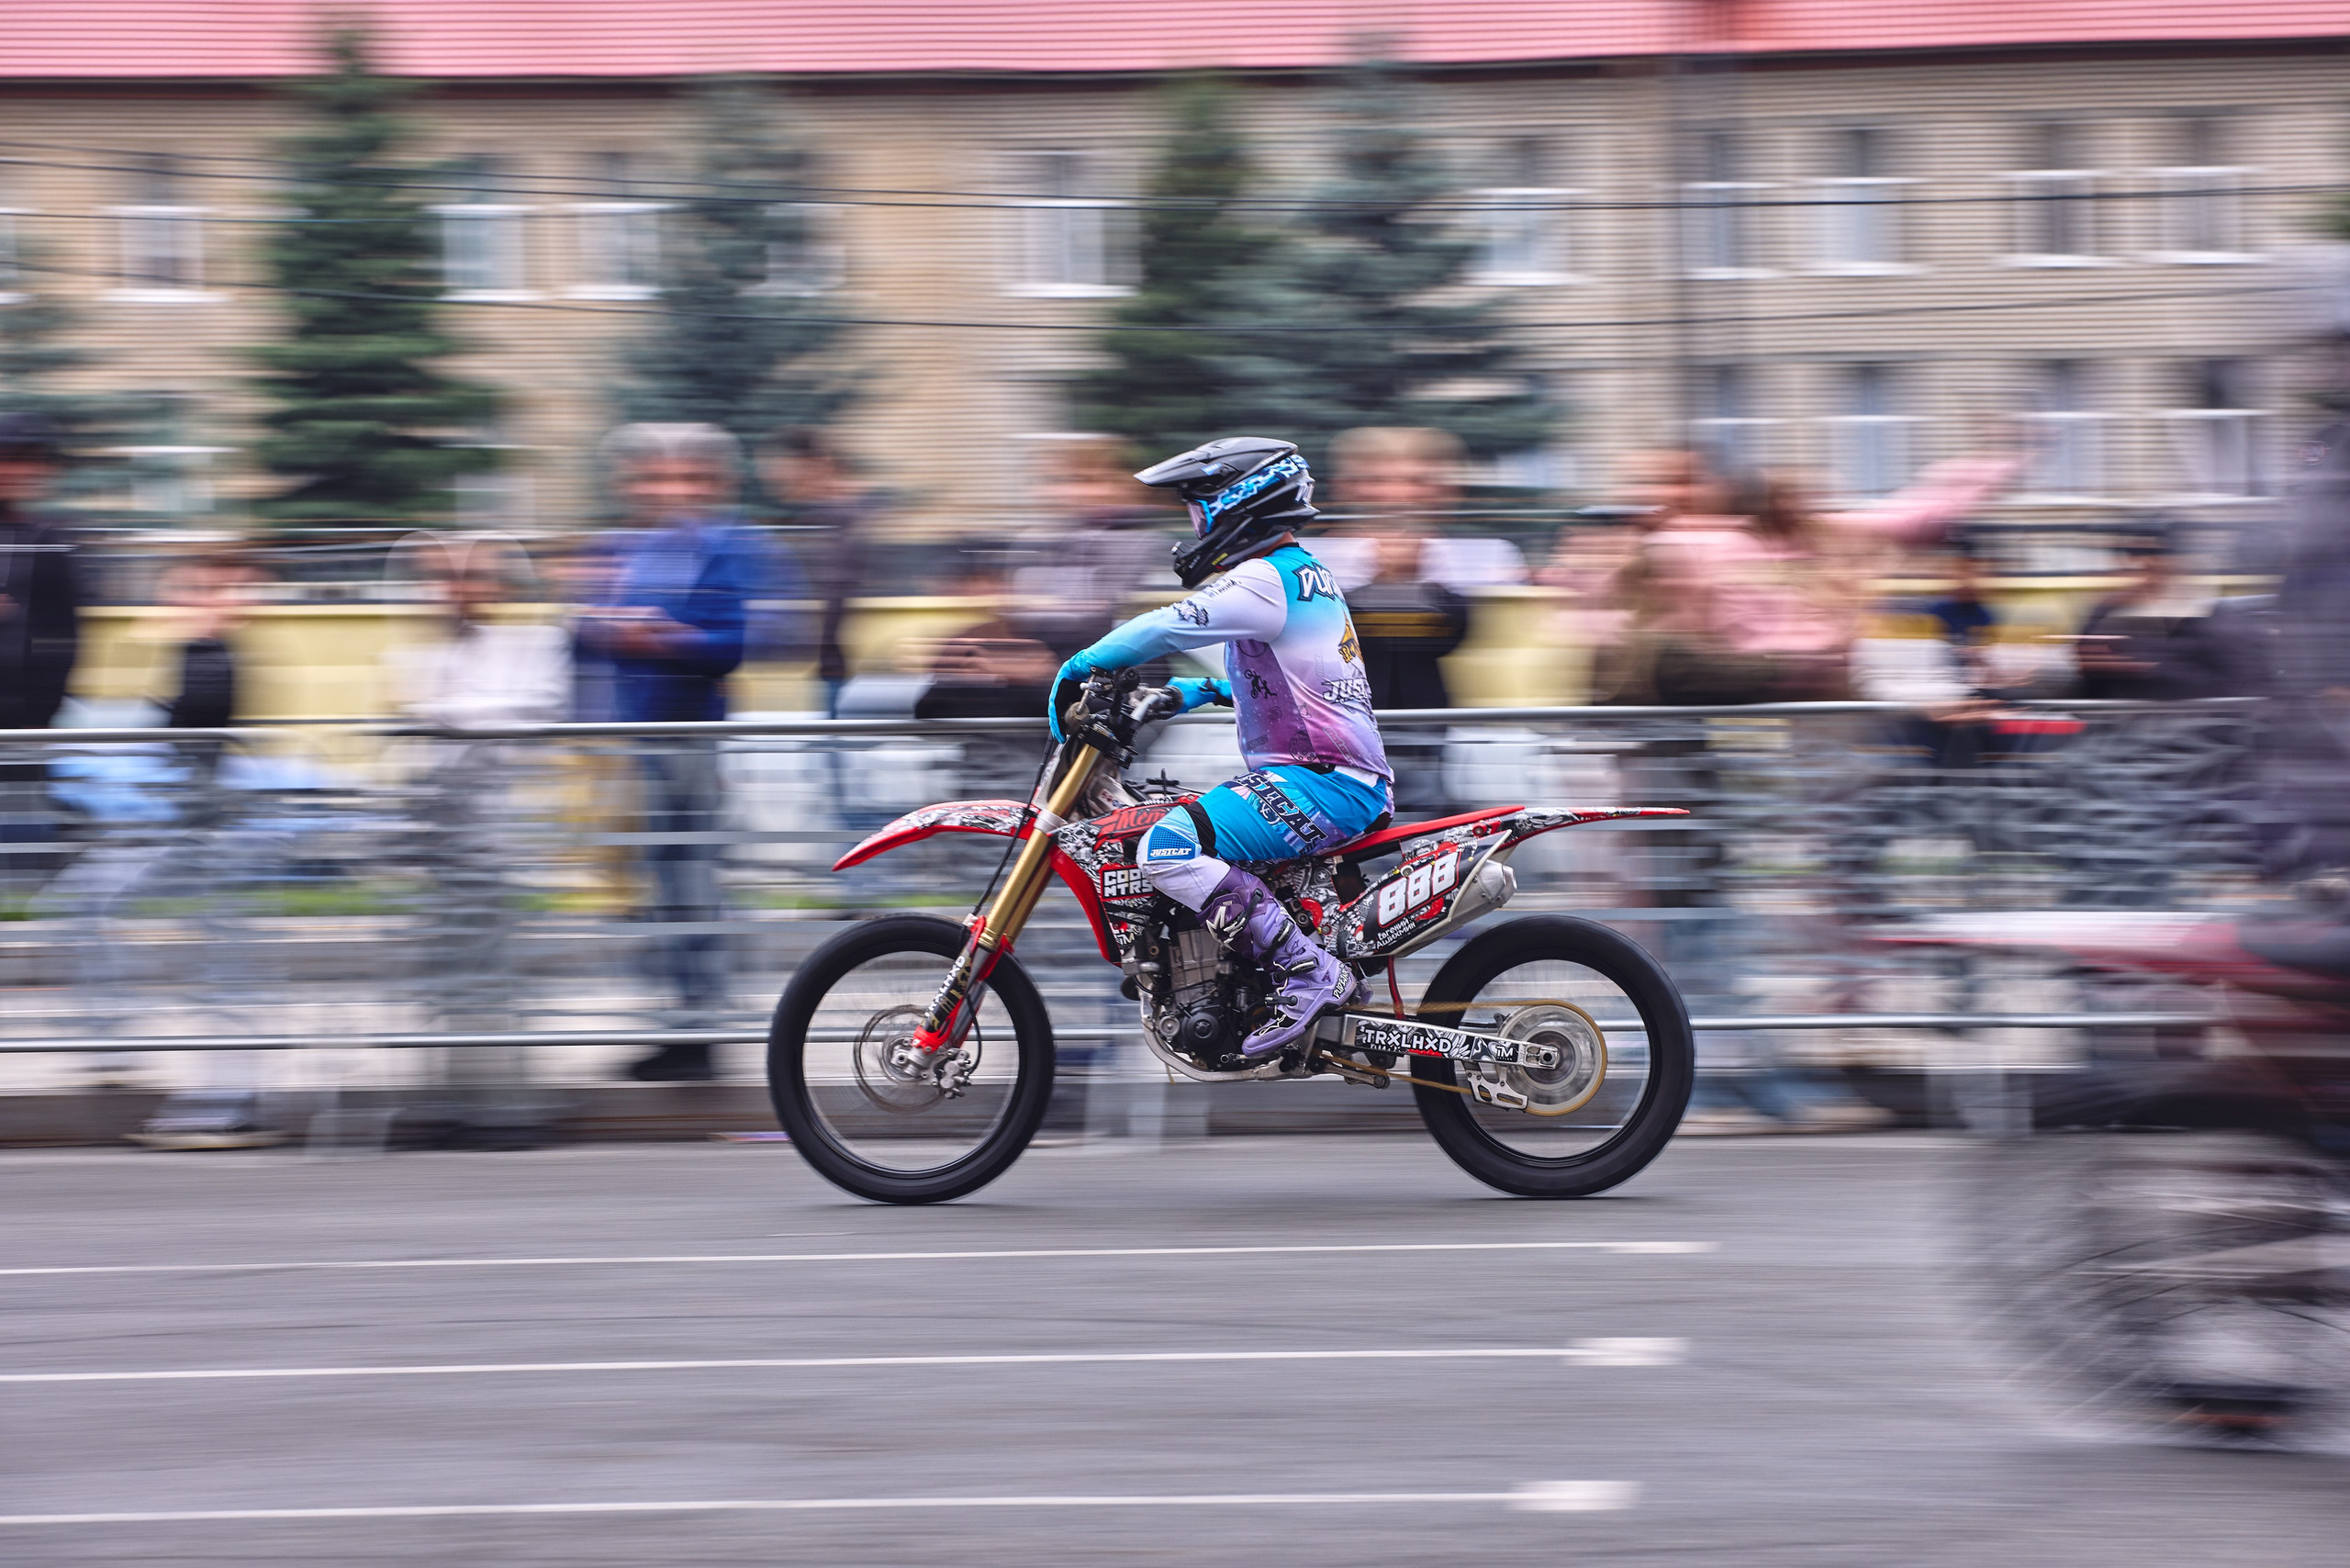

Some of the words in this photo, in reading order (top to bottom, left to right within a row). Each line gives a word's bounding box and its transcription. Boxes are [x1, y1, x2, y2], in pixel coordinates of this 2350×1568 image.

[1150, 847, 1192, 857] JUSTCAT
[1104, 879, 1154, 897] MTRS
[1379, 852, 1459, 926] 888
[1365, 1028, 1452, 1053] TRXLHXD
